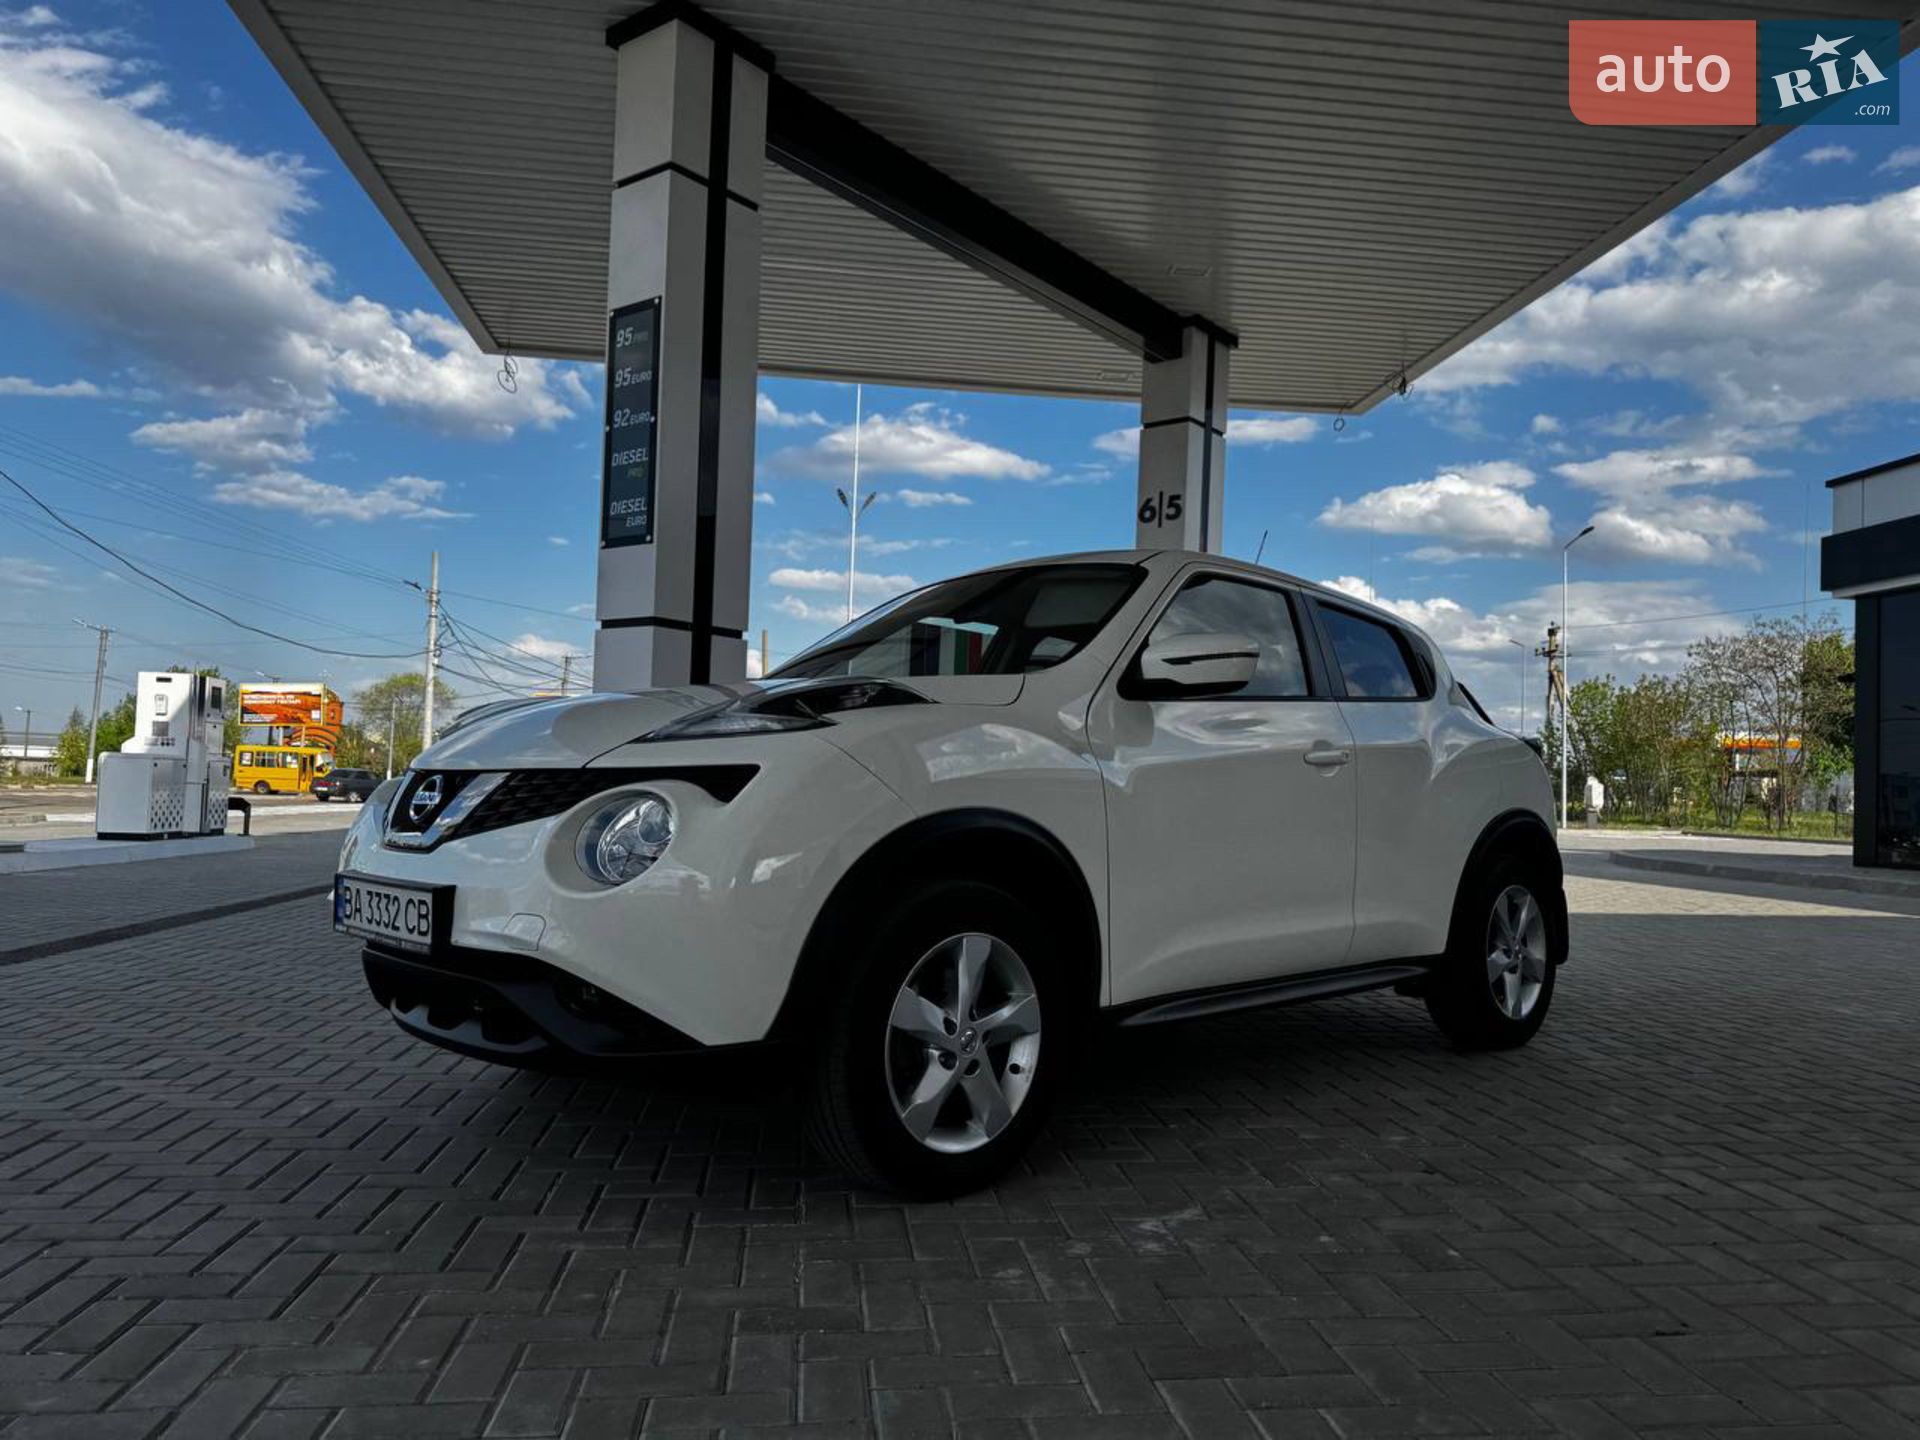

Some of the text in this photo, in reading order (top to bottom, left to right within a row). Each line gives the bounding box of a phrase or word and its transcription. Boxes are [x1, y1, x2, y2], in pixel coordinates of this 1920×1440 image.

[616, 327, 633, 348] 95
[615, 368, 652, 388] 95 EURO
[613, 408, 650, 428] 92 EURO
[612, 448, 649, 467] DIESEL
[610, 499, 647, 516] DIESEL
[626, 514, 647, 528] EURO
[344, 887, 430, 936] BA 3332 CB
